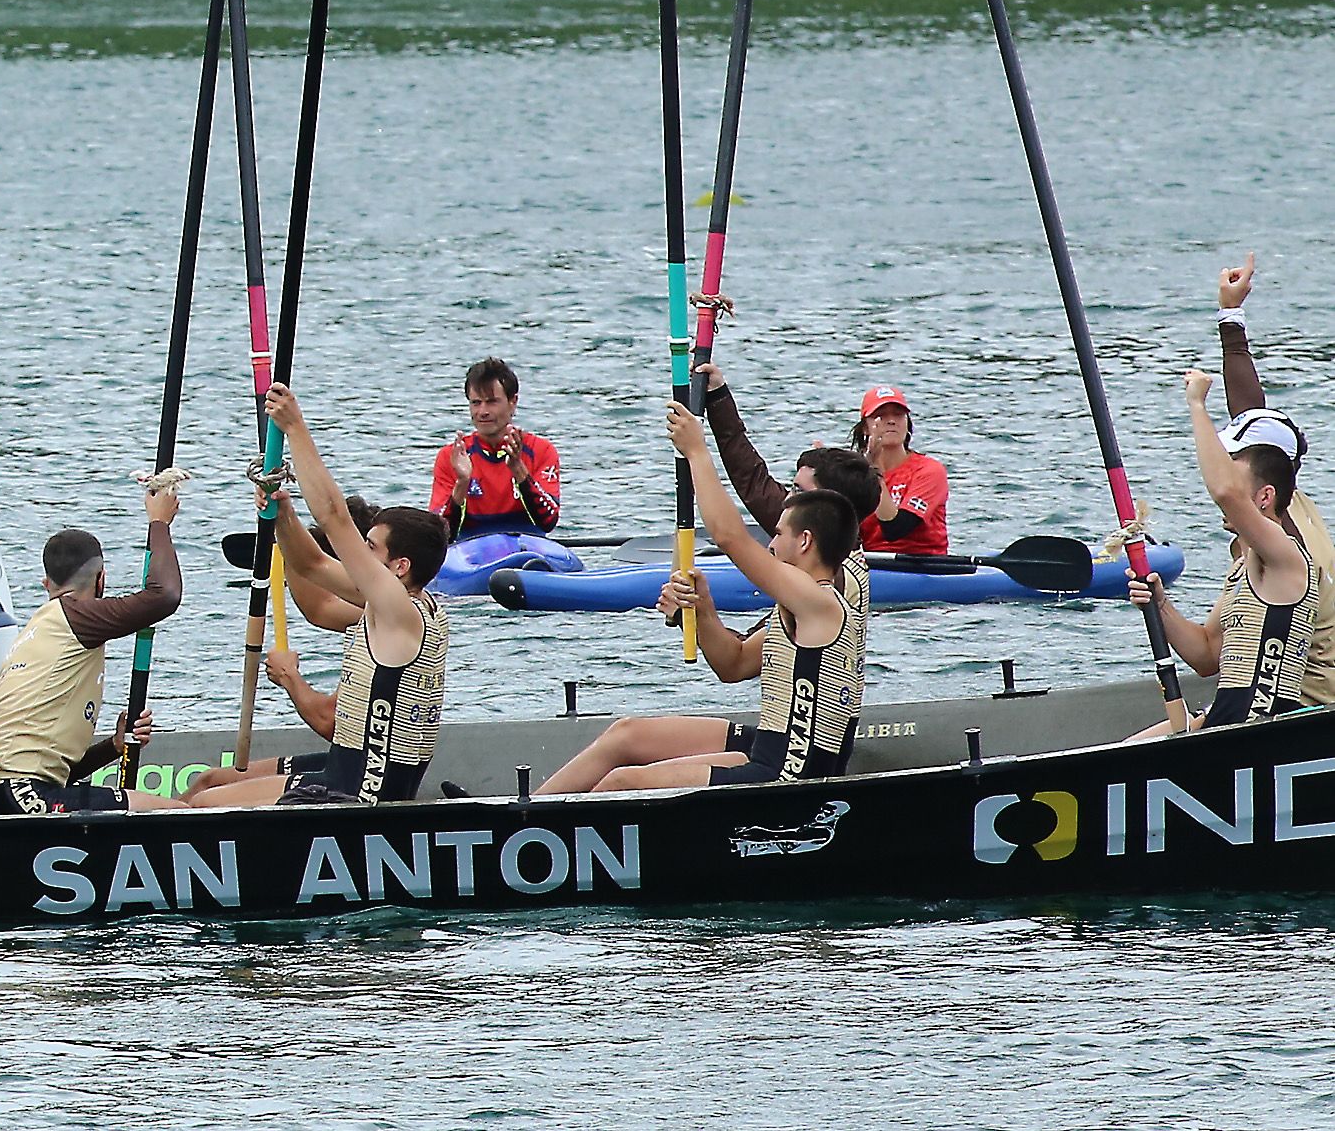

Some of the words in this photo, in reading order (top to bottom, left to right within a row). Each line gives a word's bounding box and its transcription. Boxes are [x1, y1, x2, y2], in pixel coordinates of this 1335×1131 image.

[855, 722, 916, 739] LIBIA
[32, 841, 242, 915] SAN
[296, 825, 642, 904] ANTON
